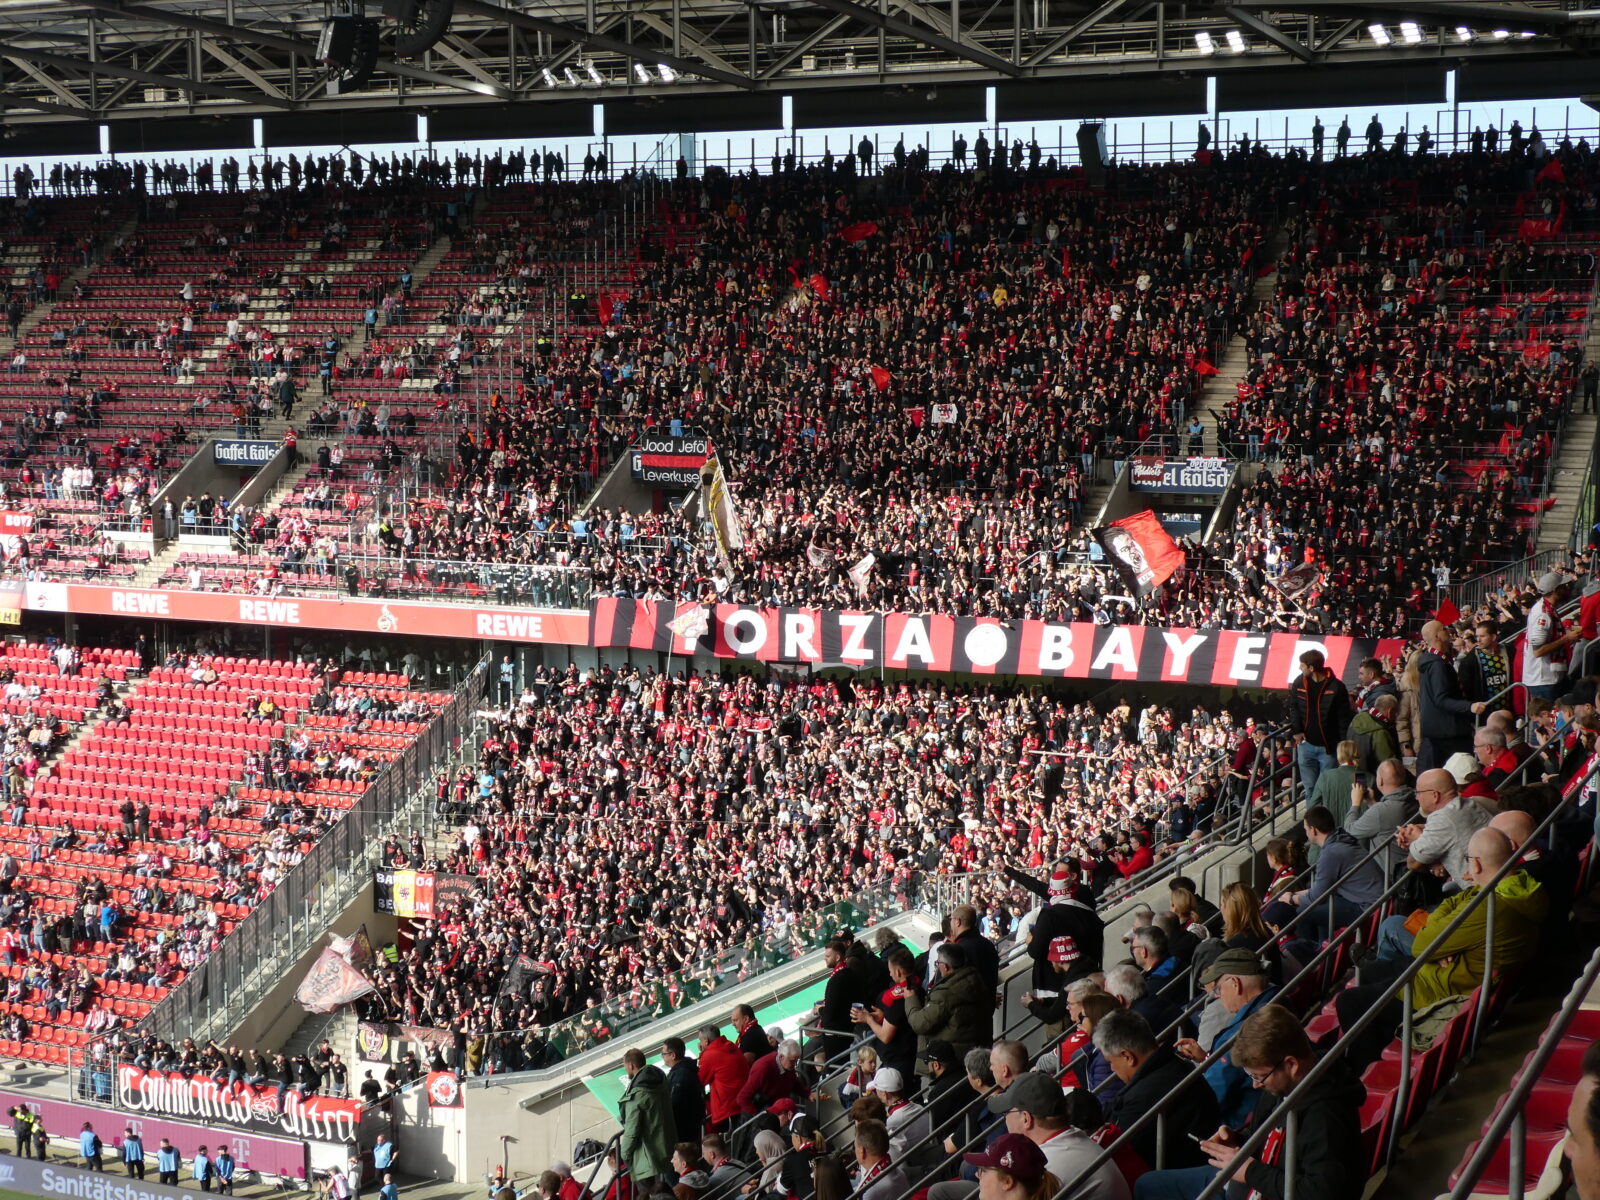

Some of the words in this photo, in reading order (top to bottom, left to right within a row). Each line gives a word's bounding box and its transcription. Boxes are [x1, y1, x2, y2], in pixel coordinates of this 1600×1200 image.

[215, 443, 248, 460] Gaffel
[642, 439, 673, 453] Jood
[112, 591, 170, 615] REWE
[239, 599, 300, 624] REWE
[476, 613, 543, 639] REWE
[415, 876, 433, 888] 04
